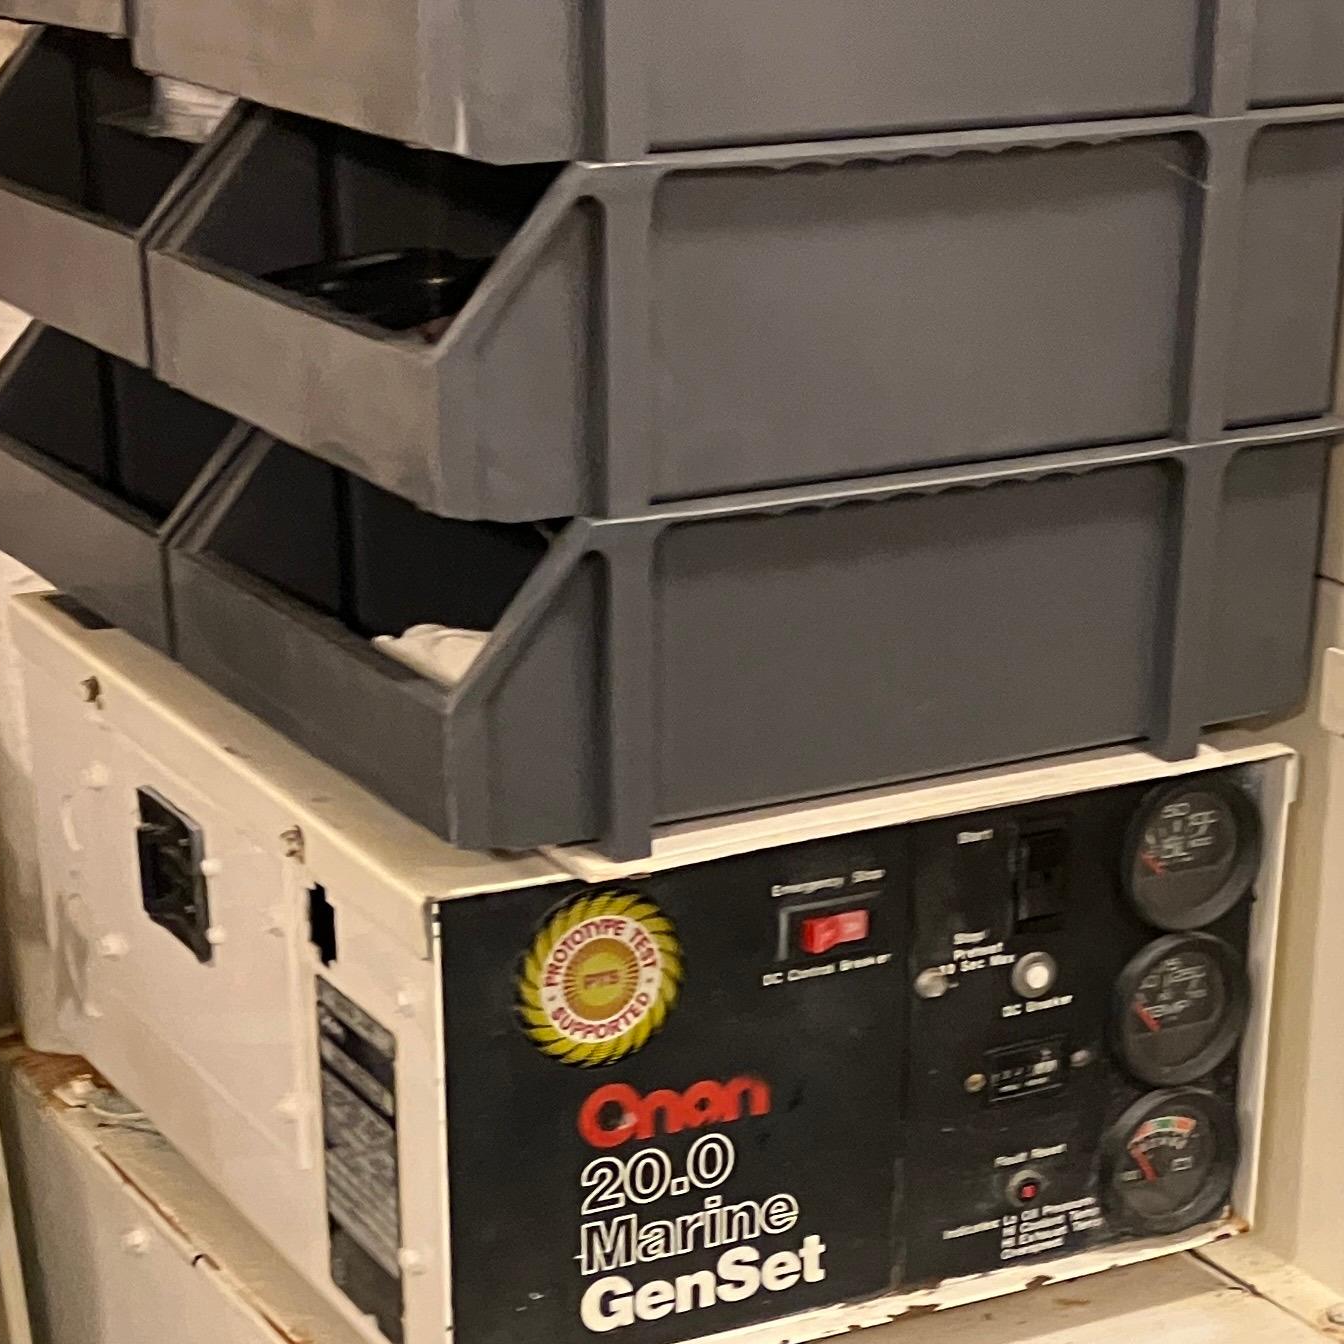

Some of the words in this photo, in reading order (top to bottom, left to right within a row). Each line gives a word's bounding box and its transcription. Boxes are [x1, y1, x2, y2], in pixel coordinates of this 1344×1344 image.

[771, 877, 844, 897] Emergency
[545, 918, 627, 988] PROTOTYPE
[629, 927, 657, 968] TEST
[787, 964, 835, 981] Control
[840, 953, 893, 971] Breaker
[551, 992, 650, 1040] SUPPORTED
[577, 1074, 773, 1148] Onan
[580, 1132, 736, 1216] 20.0
[580, 1193, 799, 1276] Marine
[580, 1234, 826, 1333] GenSet
